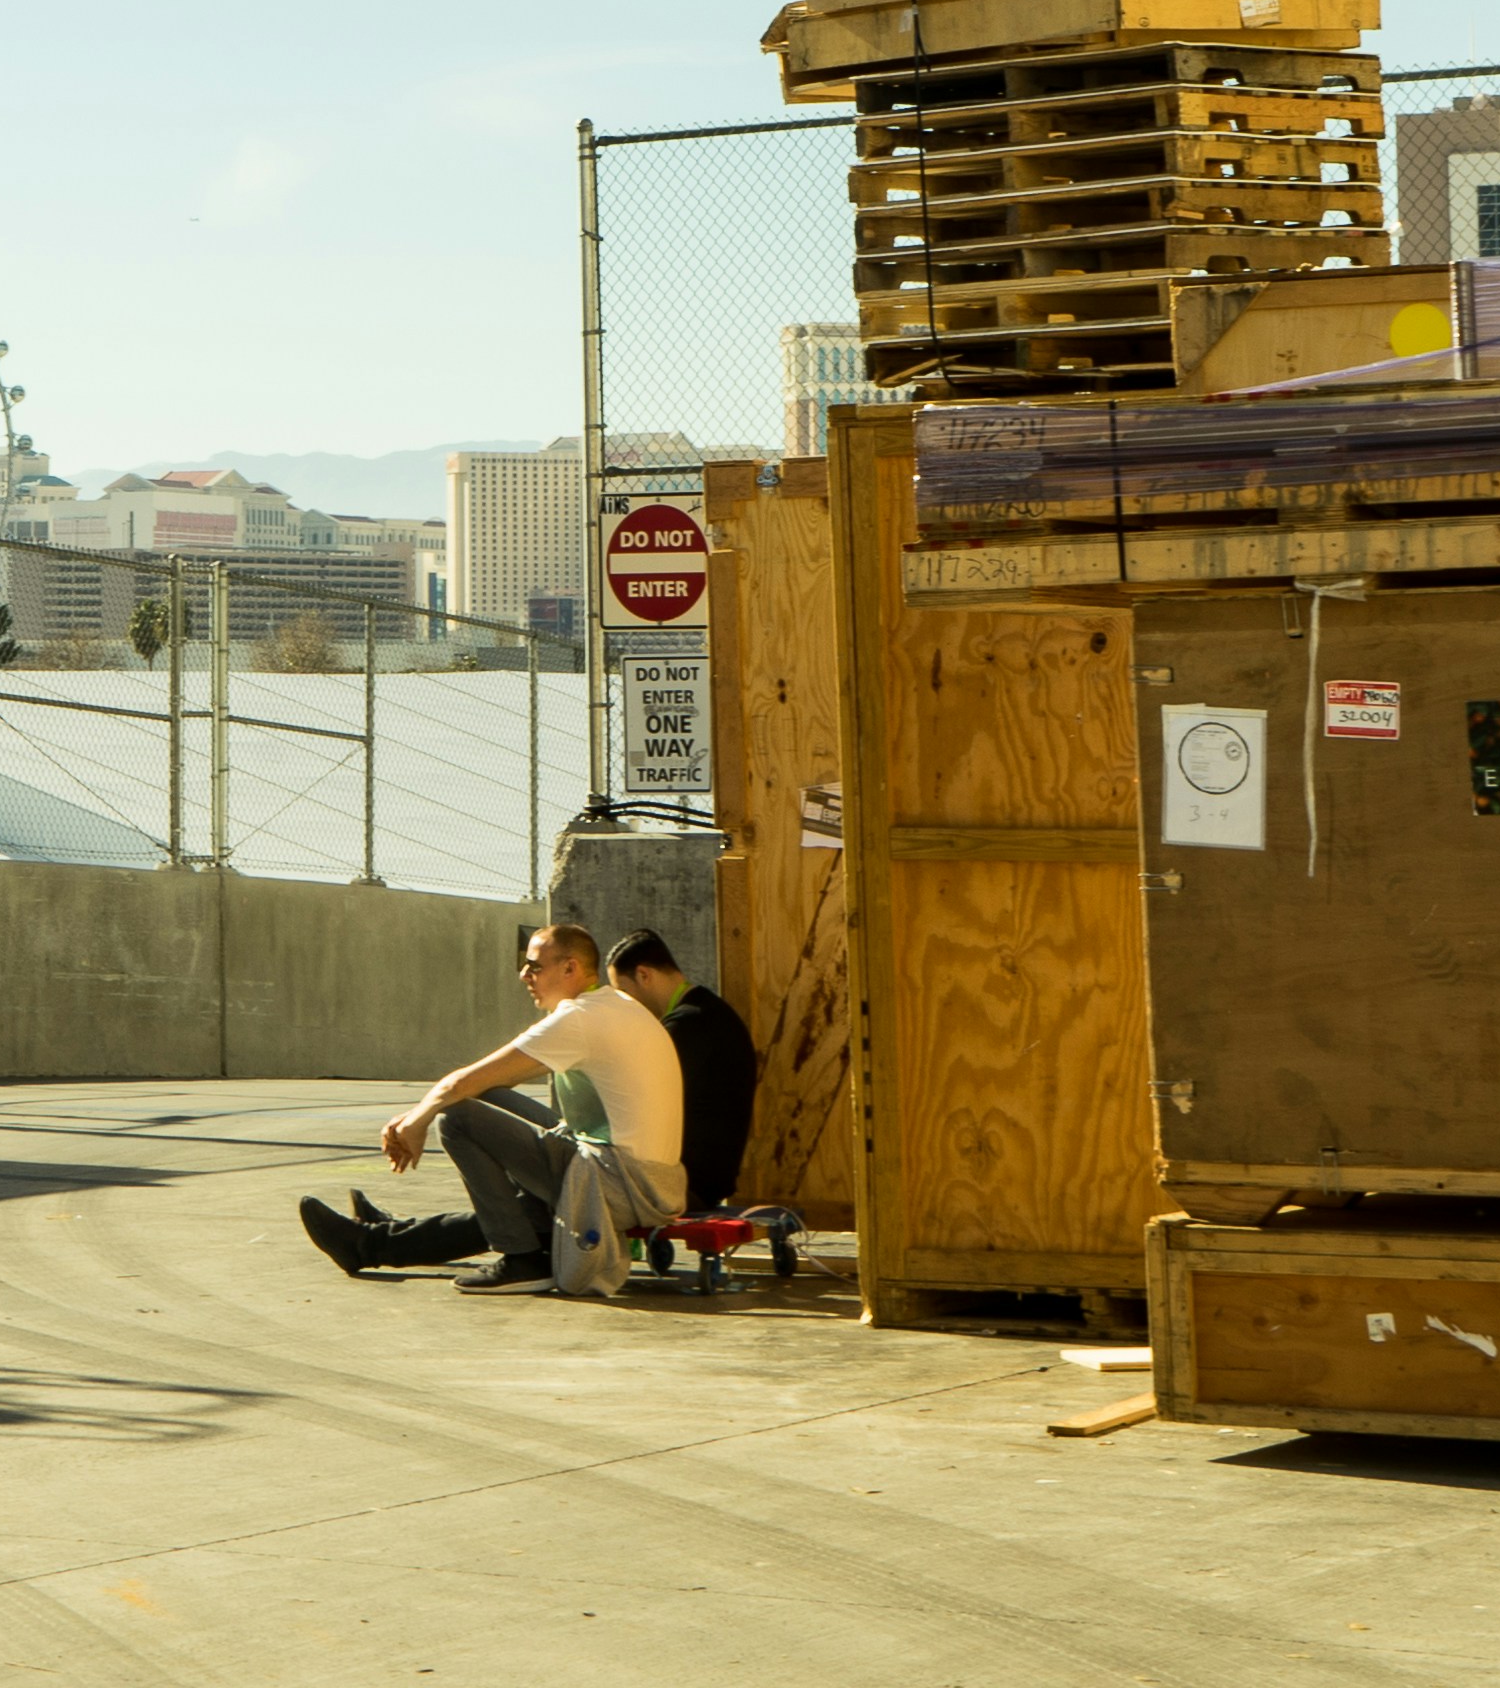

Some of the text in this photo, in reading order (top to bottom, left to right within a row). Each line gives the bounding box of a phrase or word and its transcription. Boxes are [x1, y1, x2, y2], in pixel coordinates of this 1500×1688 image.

[620, 530, 695, 548] DO NOT
[627, 581, 688, 598] ENTER
[636, 667, 700, 682] DO NOT
[642, 690, 694, 705] ENTER
[1329, 687, 1363, 699] EMPTY
[646, 715, 692, 734] ONE
[1339, 711, 1394, 727] 32004
[645, 739, 694, 758] WAY
[637, 768, 702, 782] TRAFFIC
